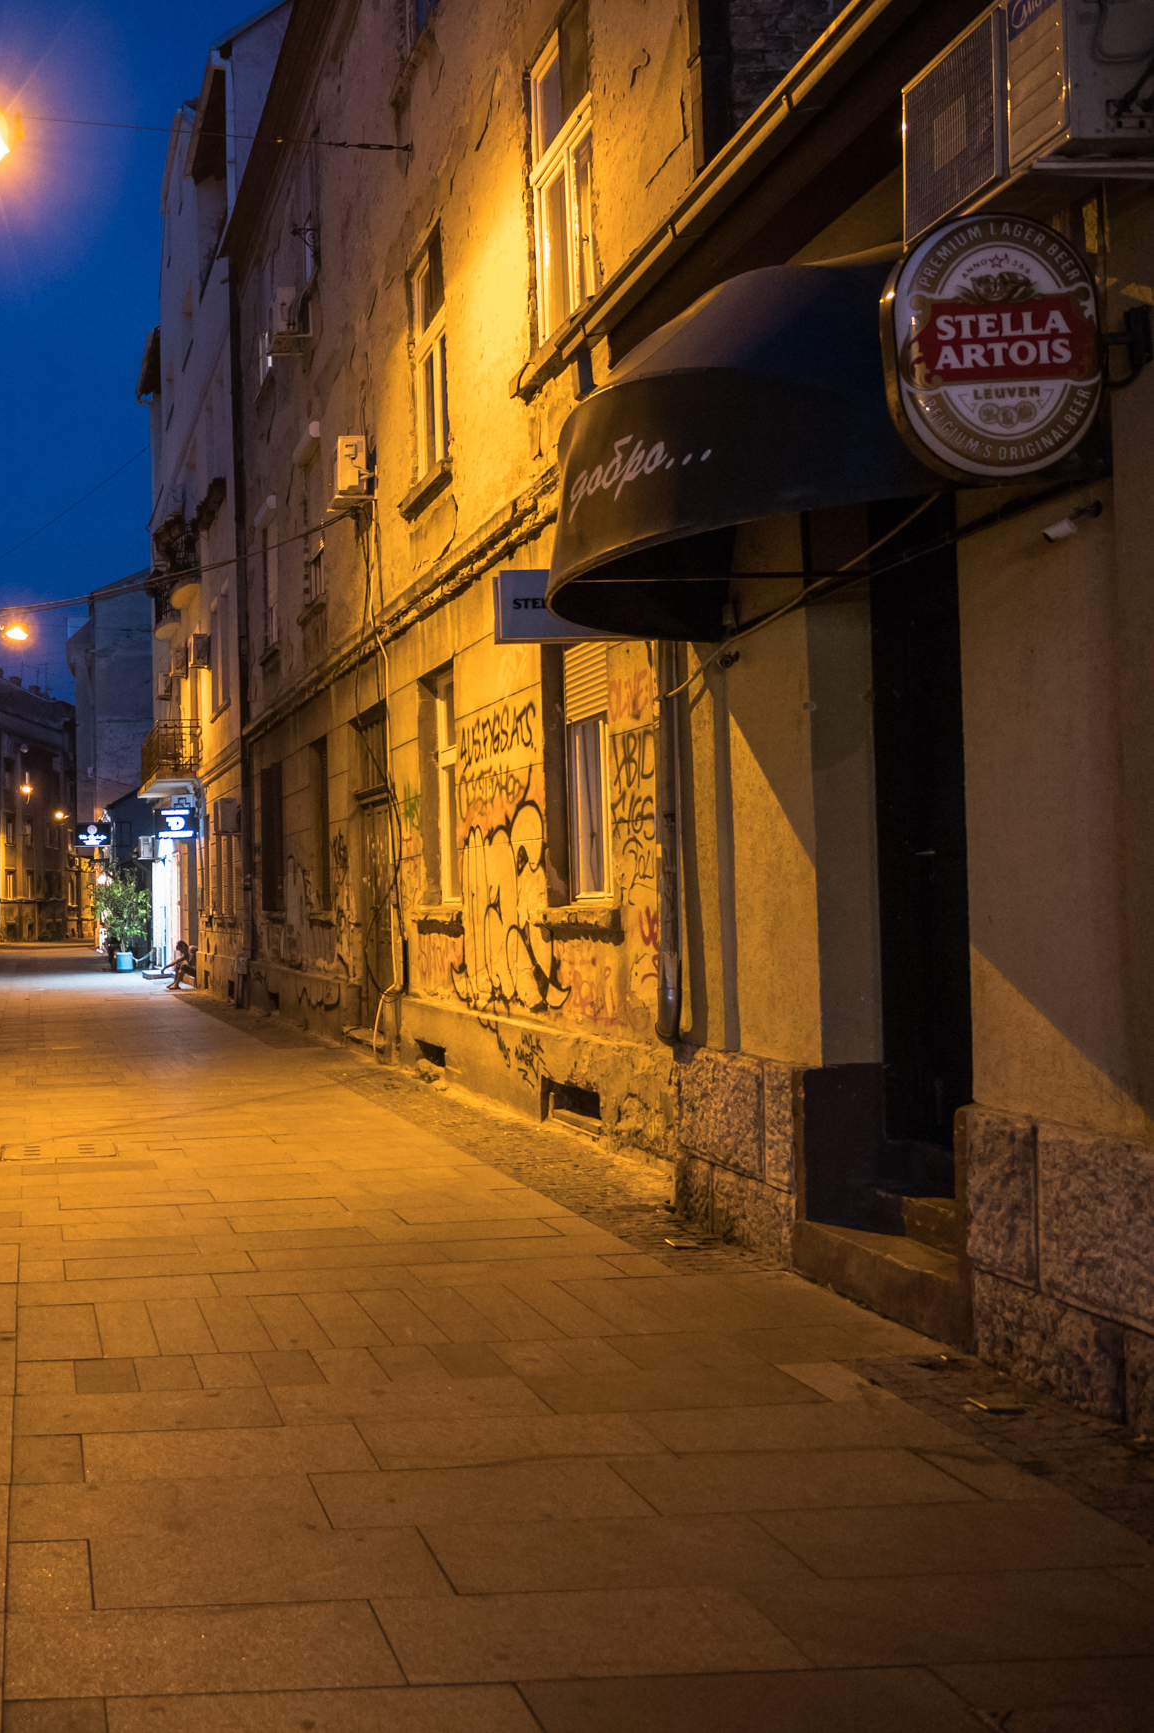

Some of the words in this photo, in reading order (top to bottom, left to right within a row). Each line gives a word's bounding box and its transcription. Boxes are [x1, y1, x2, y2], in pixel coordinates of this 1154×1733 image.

[918, 225, 983, 288] PREMIUM
[989, 221, 1046, 247] LAGER
[1047, 243, 1081, 281] BEER
[961, 259, 988, 280] ANNO
[935, 310, 1072, 341] STELLA
[935, 338, 1073, 370] ARTOIS
[973, 386, 1041, 400] LEUVEN
[924, 397, 993, 459] BELGIUM'S
[998, 424, 1070, 461] ORIGINAL
[1063, 388, 1092, 427] BEER
